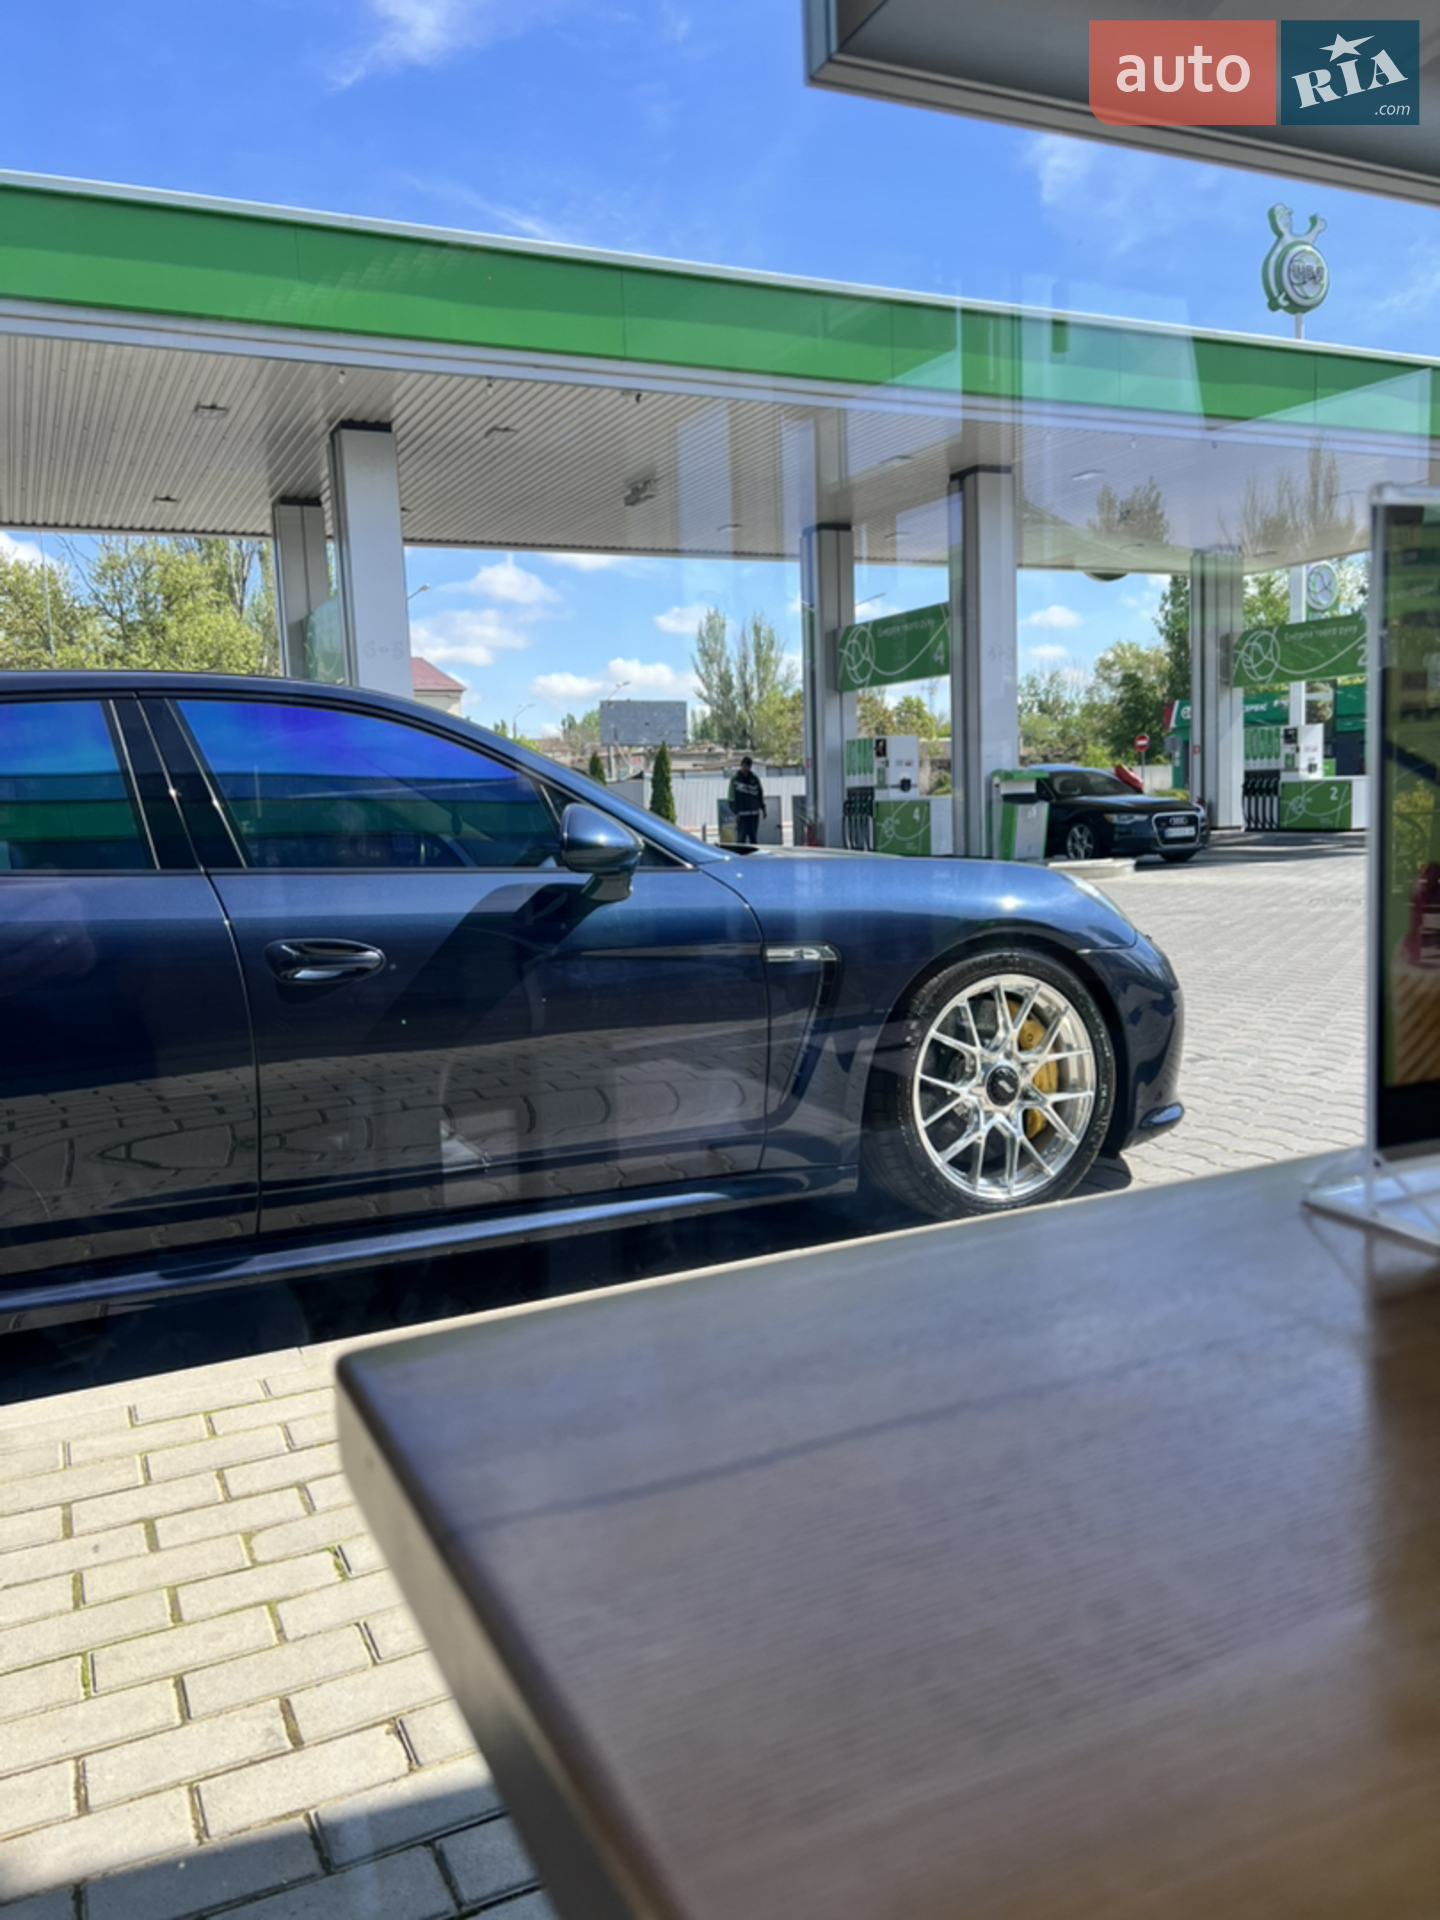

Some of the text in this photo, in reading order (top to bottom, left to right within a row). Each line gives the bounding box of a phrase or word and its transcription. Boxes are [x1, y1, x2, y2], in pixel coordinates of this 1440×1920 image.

[933, 640, 946, 666] 4
[1329, 785, 1339, 801] 2
[912, 807, 921, 822] 4
